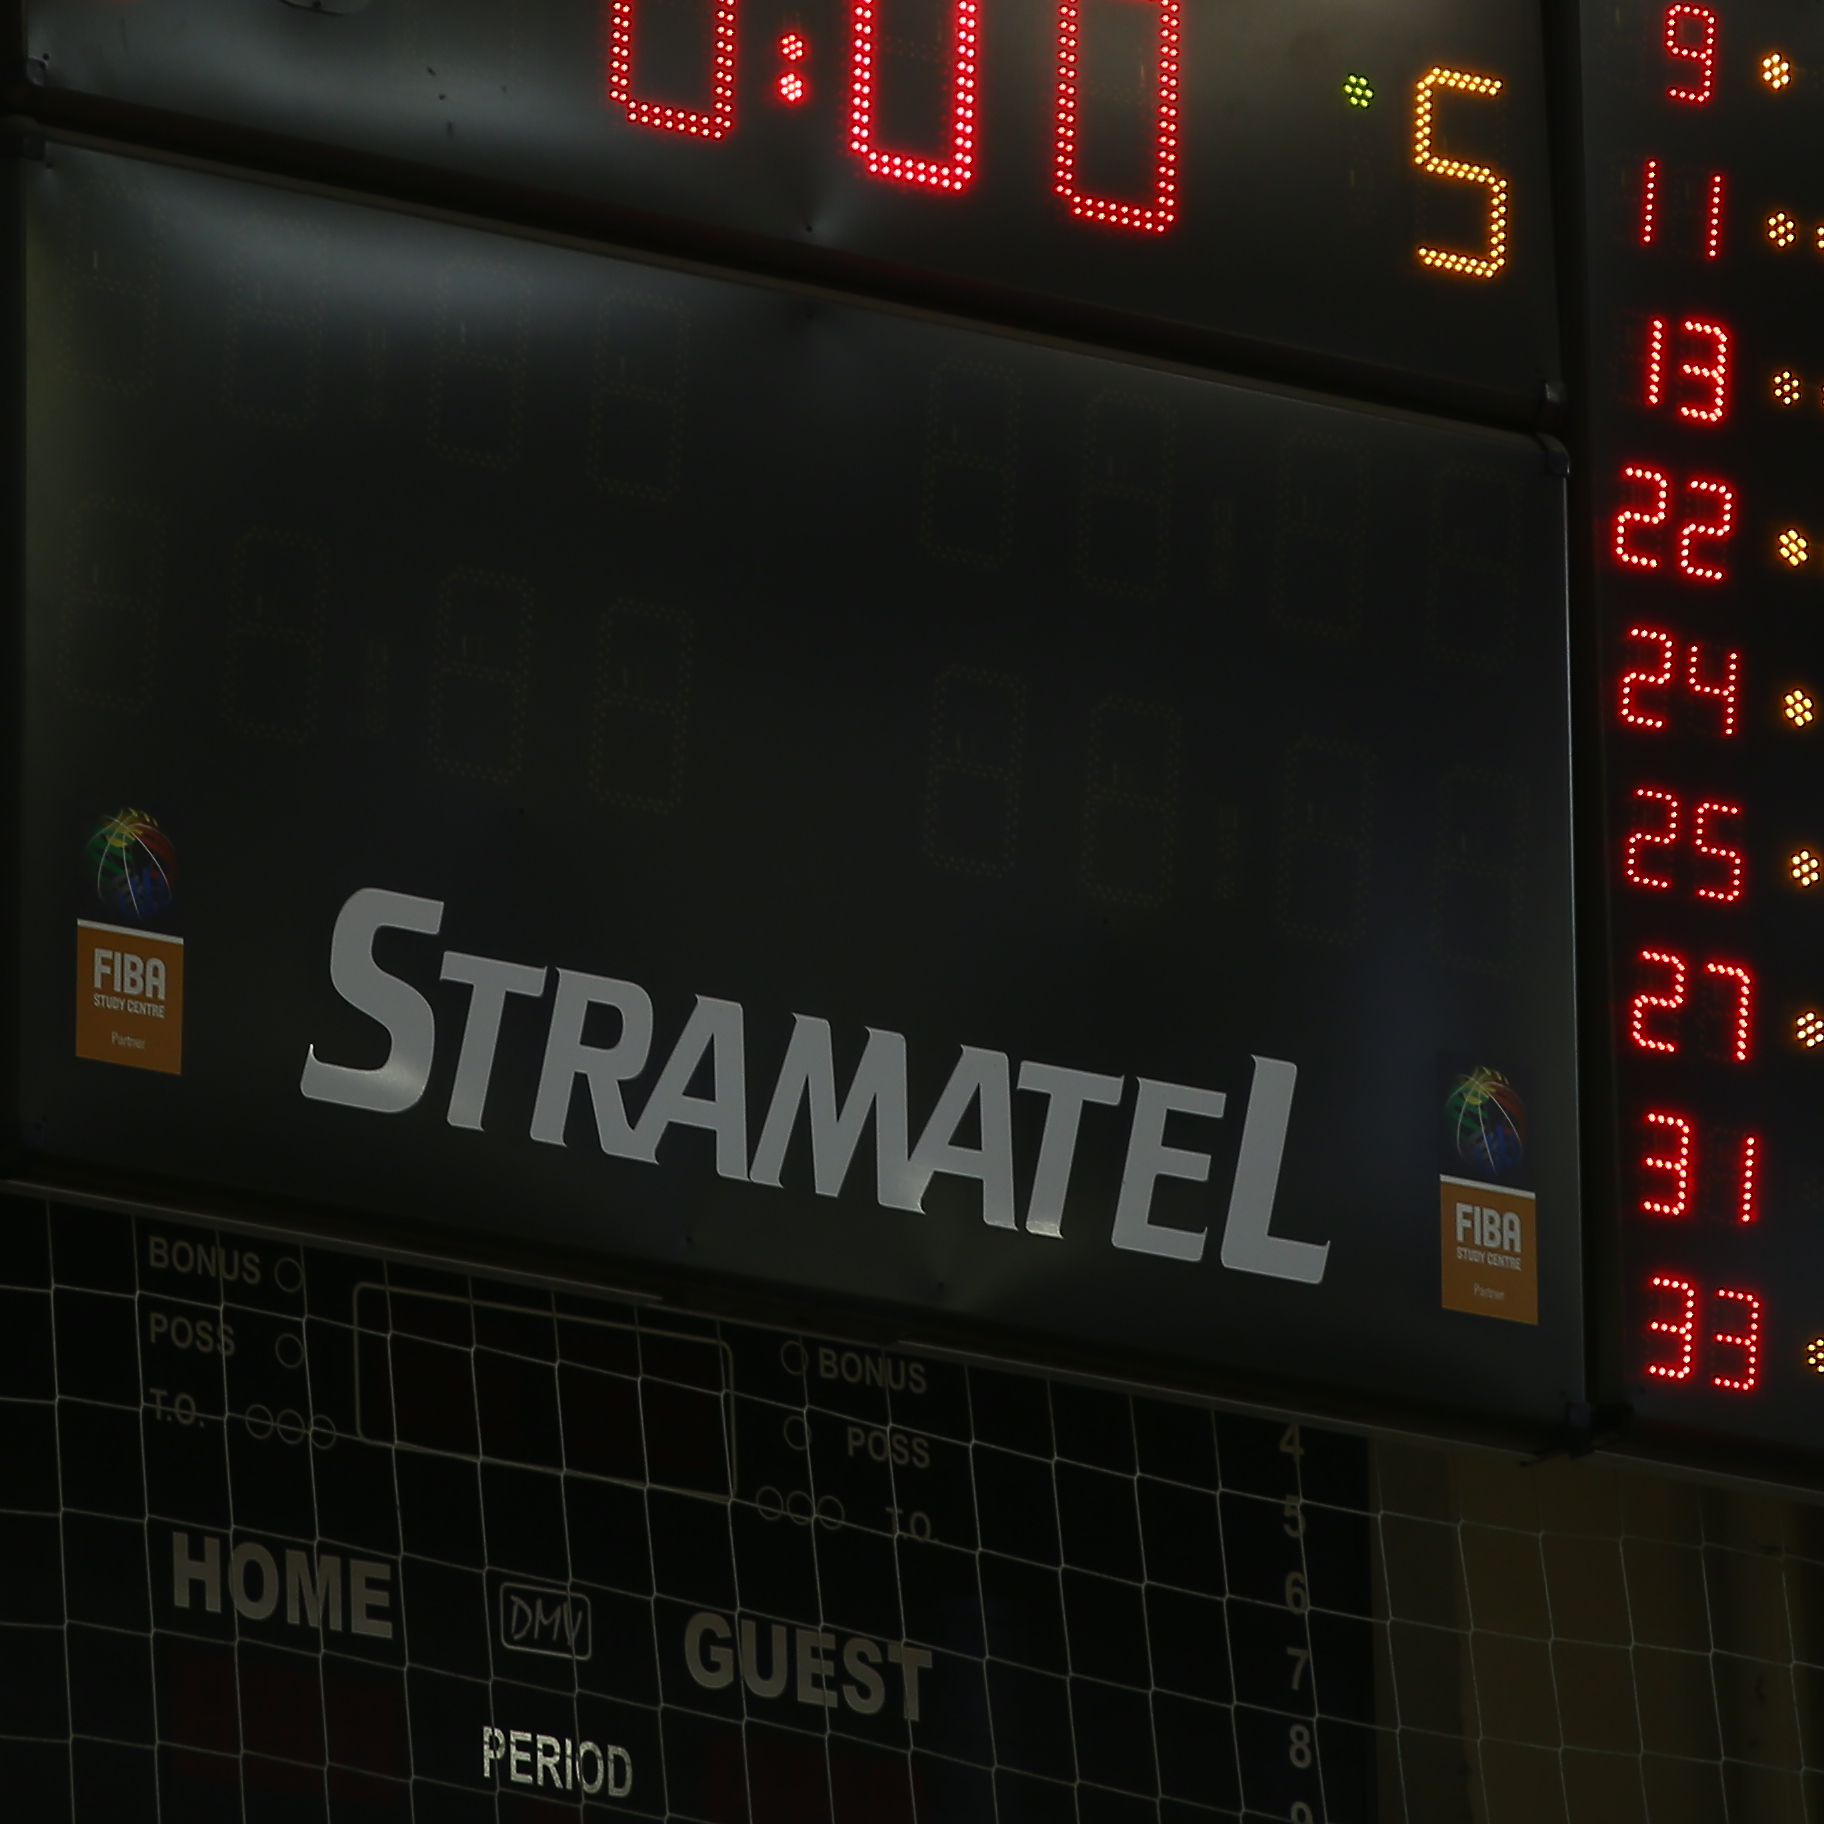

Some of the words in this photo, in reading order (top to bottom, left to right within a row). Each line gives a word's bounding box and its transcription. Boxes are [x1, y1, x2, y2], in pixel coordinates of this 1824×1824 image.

[1662, 2, 1717, 104] 9
[1411, 64, 1508, 280] 5
[1640, 158, 1723, 259] 11
[1644, 316, 1732, 425] 13
[1611, 462, 1734, 582] 22
[1618, 626, 1739, 736] 24
[1624, 786, 1744, 904] 25
[93, 947, 166, 1000] FIBA
[1628, 948, 1753, 1062] 27
[93, 993, 126, 1012] STUDY
[126, 998, 165, 1019] CENTRE
[301, 886, 1332, 1285] STRAMATEL
[1640, 1110, 1759, 1224] 31
[1455, 1202, 1522, 1253] FIBA
[1456, 1246, 1486, 1264] STUDY
[1487, 1250, 1522, 1271] CENTRE
[148, 1235, 261, 1285] BONUS
[149, 1311, 236, 1357] POSS
[1645, 1272, 1762, 1392] 33
[818, 1347, 929, 1395] BONUS
[149, 1386, 205, 1429] T.O.
[846, 1426, 930, 1469] POSS
[1278, 1420, 1305, 1462] 4
[1283, 1494, 1307, 1538] 5
[172, 1530, 394, 1641] HOME
[1284, 1571, 1309, 1614] 6
[683, 1611, 933, 1722] GUEST
[1286, 1646, 1309, 1691] 7
[482, 1725, 634, 1800] PERIOD
[1288, 1724, 1313, 1769] 8
